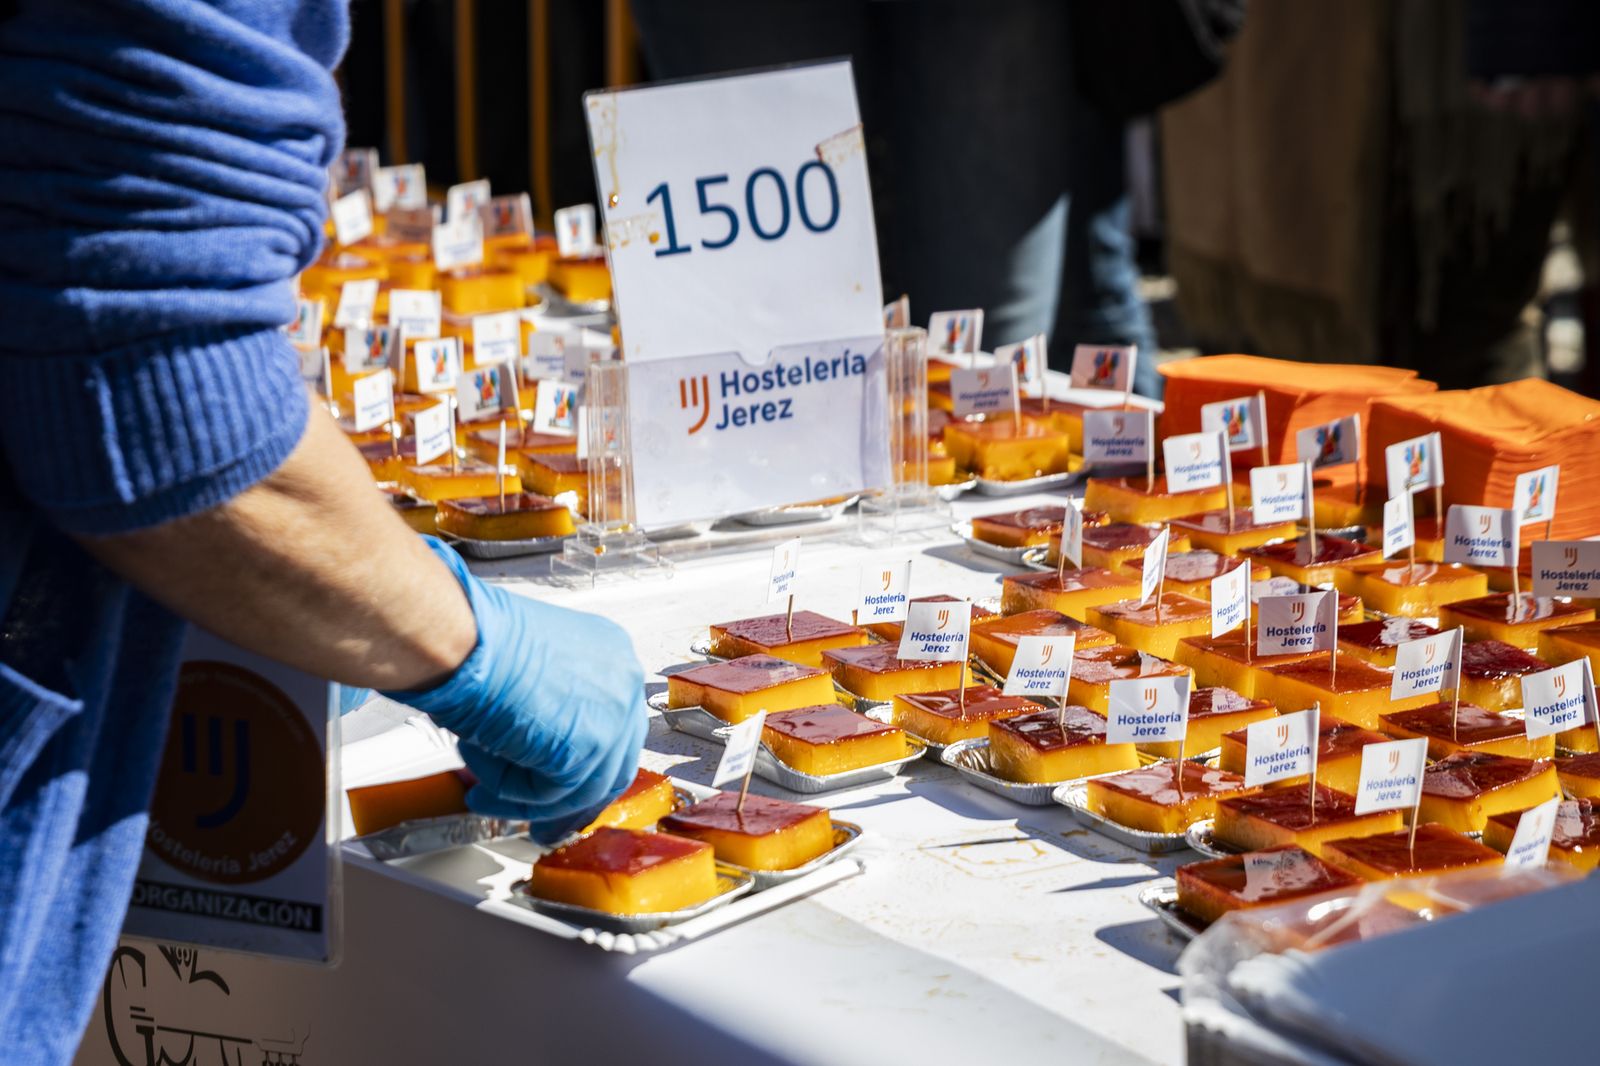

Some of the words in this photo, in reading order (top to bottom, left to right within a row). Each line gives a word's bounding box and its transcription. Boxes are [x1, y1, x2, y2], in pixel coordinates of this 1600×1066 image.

[646, 159, 841, 258] 1500
[719, 349, 868, 398] Hostelería
[715, 398, 793, 431] Jerez
[1454, 533, 1513, 550] Hostelería
[1467, 547, 1498, 558] Jerez
[1540, 568, 1600, 581] Hostelería
[1556, 580, 1589, 591] Jerez
[864, 592, 906, 606] Hostelería
[873, 604, 895, 615] Jerez
[910, 631, 964, 643] Hostelería
[1266, 622, 1327, 637] Hostelería
[921, 643, 950, 654] Jerez
[1281, 636, 1313, 648] Jerez
[1016, 667, 1064, 679] Hostelería
[1401, 661, 1453, 681] Hostelería
[1024, 678, 1051, 690] Jerez
[1412, 675, 1440, 690] Jerez
[1533, 693, 1588, 718] Hostelería
[1117, 711, 1182, 726] Hostelería
[1549, 709, 1578, 726] Jerez
[1131, 725, 1167, 737] Jerez
[1254, 745, 1311, 767] Hostelería
[1267, 760, 1298, 776] Jerez
[1364, 773, 1417, 792] Hostelería
[1375, 789, 1403, 802] Jerez
[248, 829, 298, 872] Jerez
[132, 883, 314, 930] ORGANIZACIÓN
